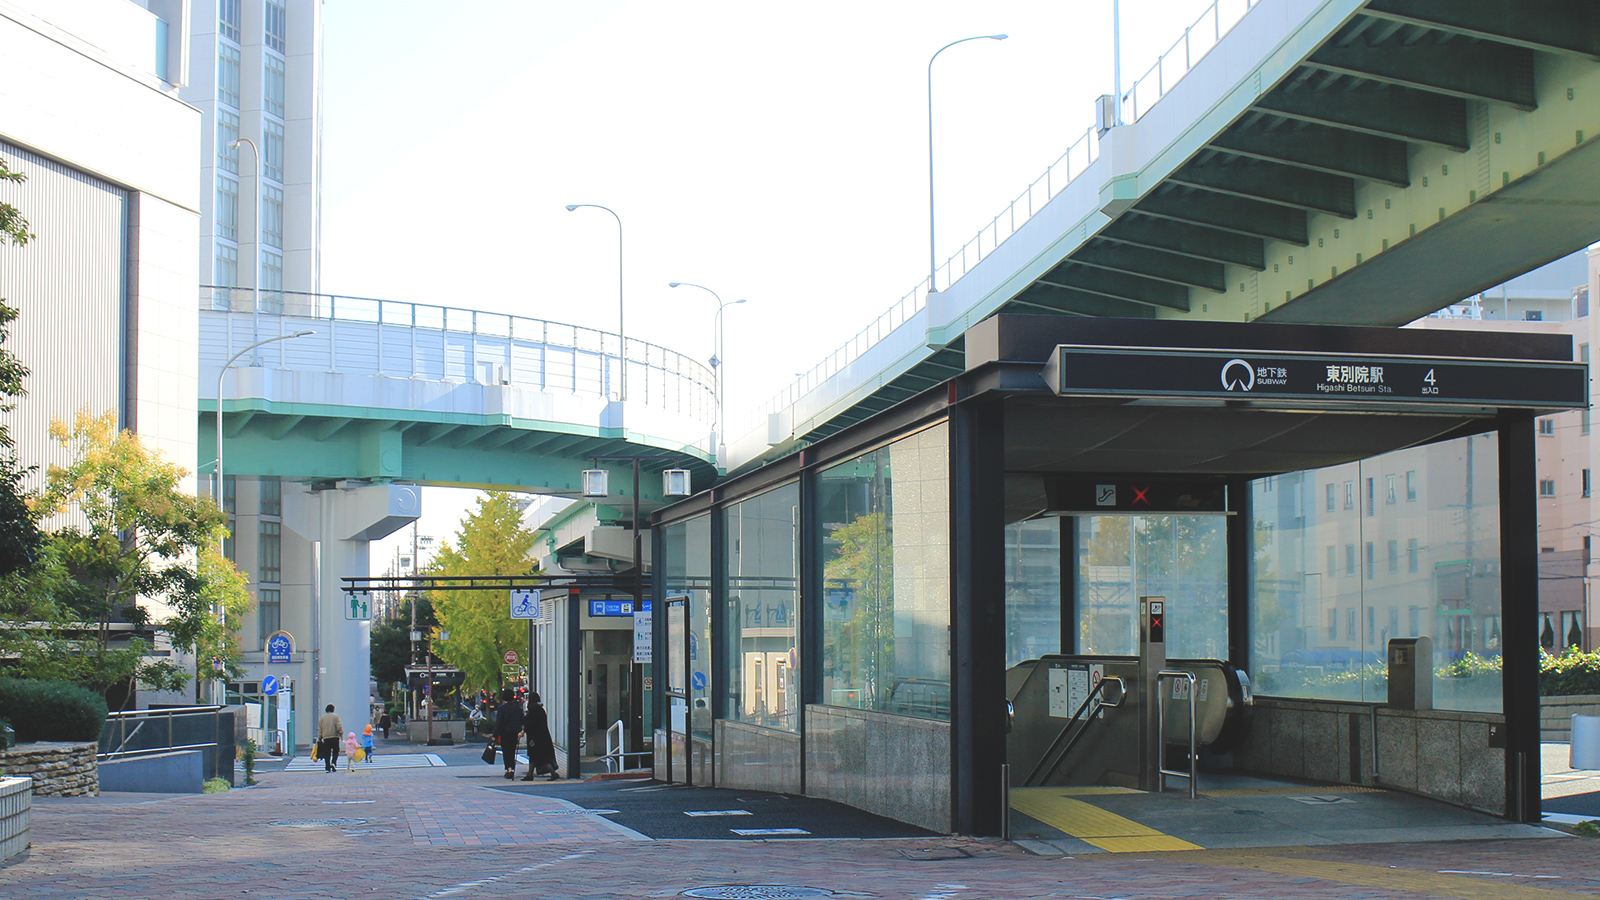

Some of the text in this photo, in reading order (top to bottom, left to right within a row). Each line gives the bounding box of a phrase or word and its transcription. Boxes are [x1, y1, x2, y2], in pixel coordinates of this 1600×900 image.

[1257, 367, 1287, 378] 地下鉄
[1326, 365, 1384, 383] 東別院駅
[1424, 368, 1437, 386] 4
[1316, 383, 1394, 393] Higashi Betsuin Sta.
[1421, 387, 1439, 395] 出入口
